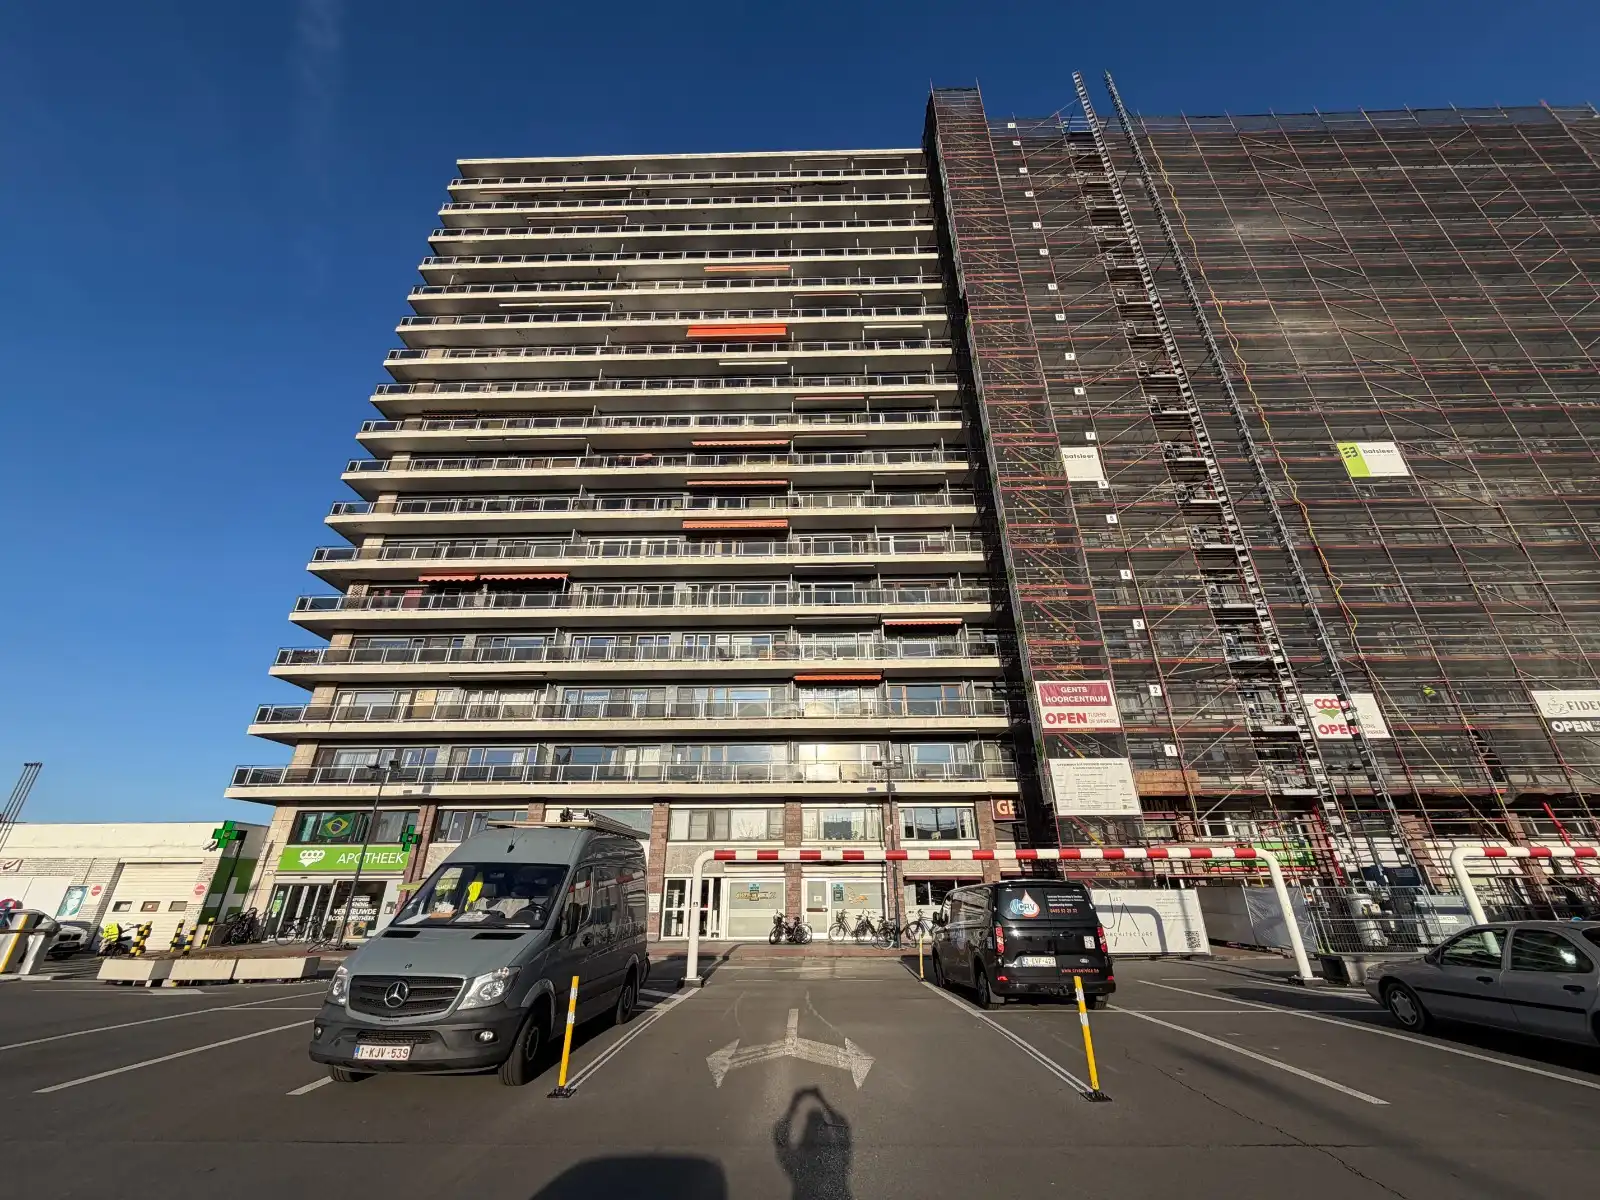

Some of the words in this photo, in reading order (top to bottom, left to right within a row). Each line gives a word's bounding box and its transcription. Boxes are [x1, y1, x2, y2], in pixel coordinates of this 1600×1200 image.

[1045, 695, 1108, 703] HOORCENTRUM
[1045, 712, 1088, 725] OPEN
[1551, 720, 1595, 733] OPEN
[336, 852, 405, 865] APOTHEEK
[359, 1047, 409, 1059] 1-KJV-539
